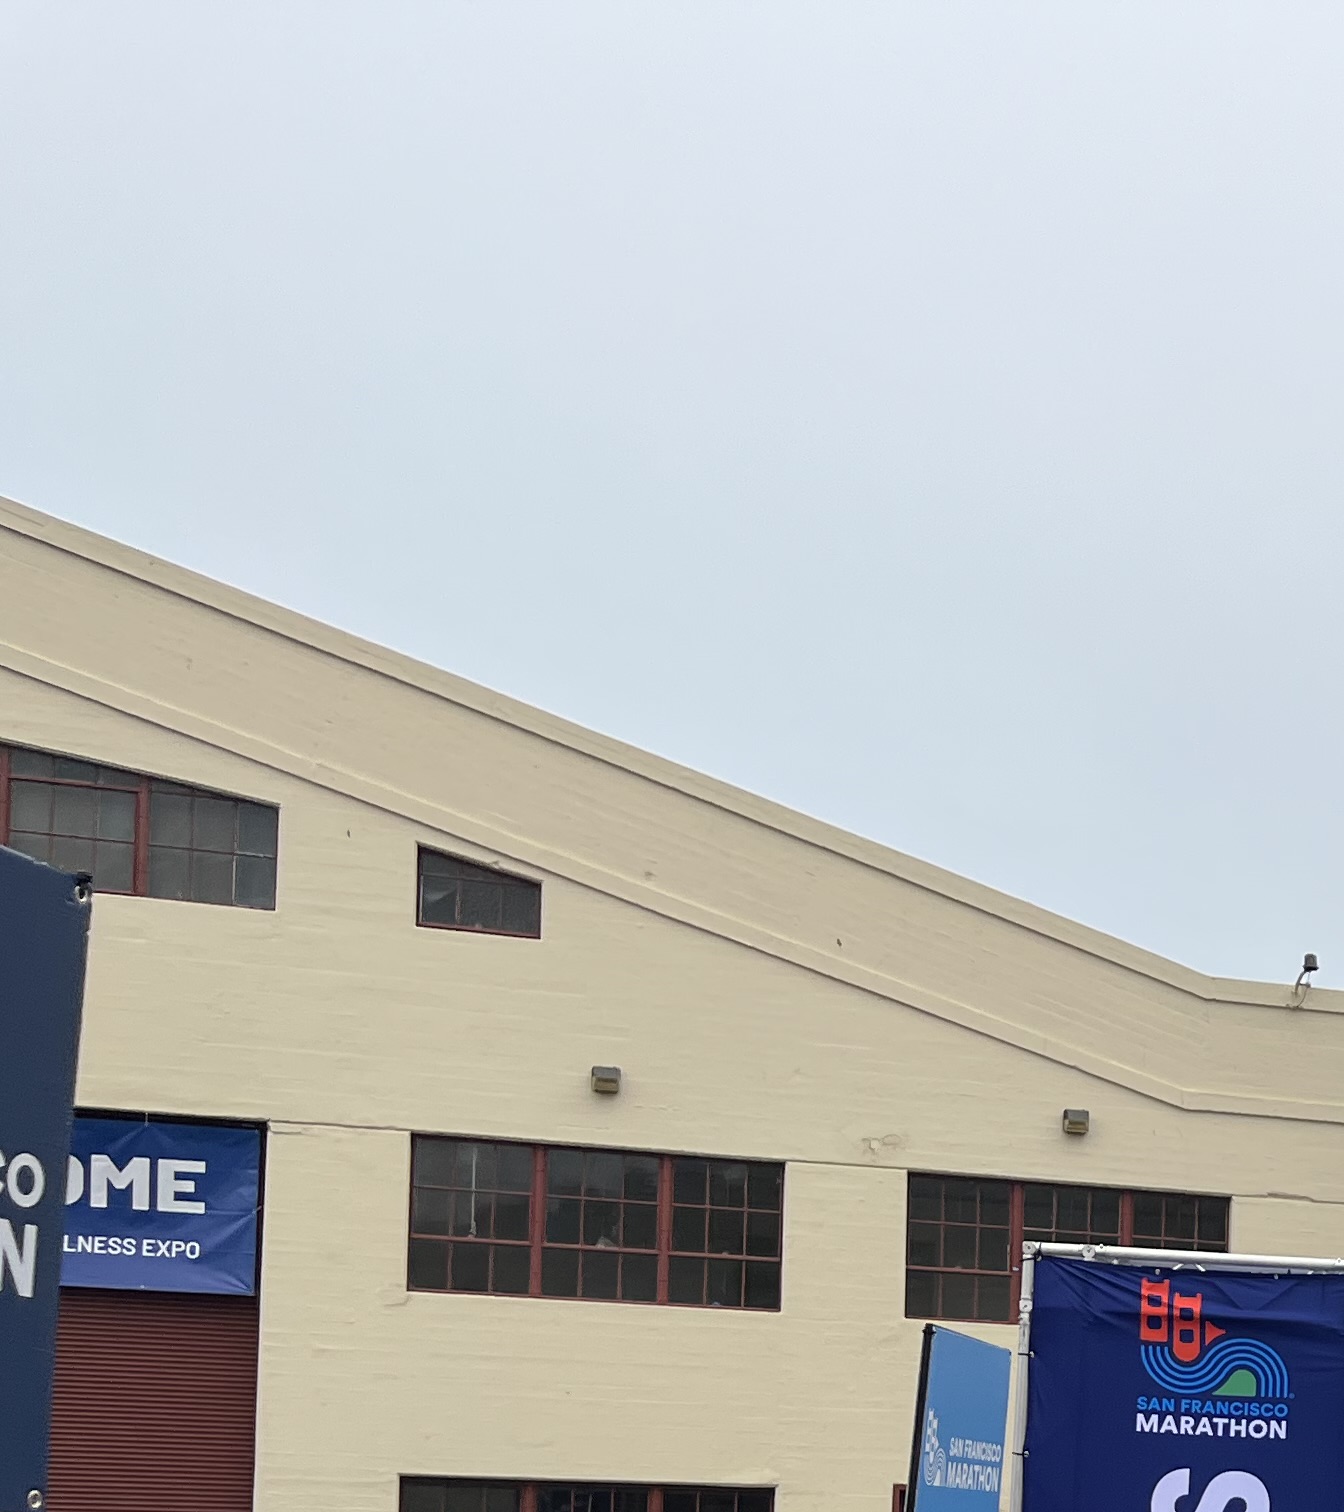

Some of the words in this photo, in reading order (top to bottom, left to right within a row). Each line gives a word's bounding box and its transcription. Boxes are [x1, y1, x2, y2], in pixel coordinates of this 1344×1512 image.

[142, 1239, 201, 1260] EXPO
[1136, 1396, 1175, 1412] SAN
[1180, 1399, 1288, 1417] FRANCISCO
[1135, 1413, 1288, 1440] MARATHON
[949, 1437, 965, 1457] SAN
[963, 1439, 1002, 1463] FRANCISCO
[946, 1461, 1000, 1493] MARATHON
